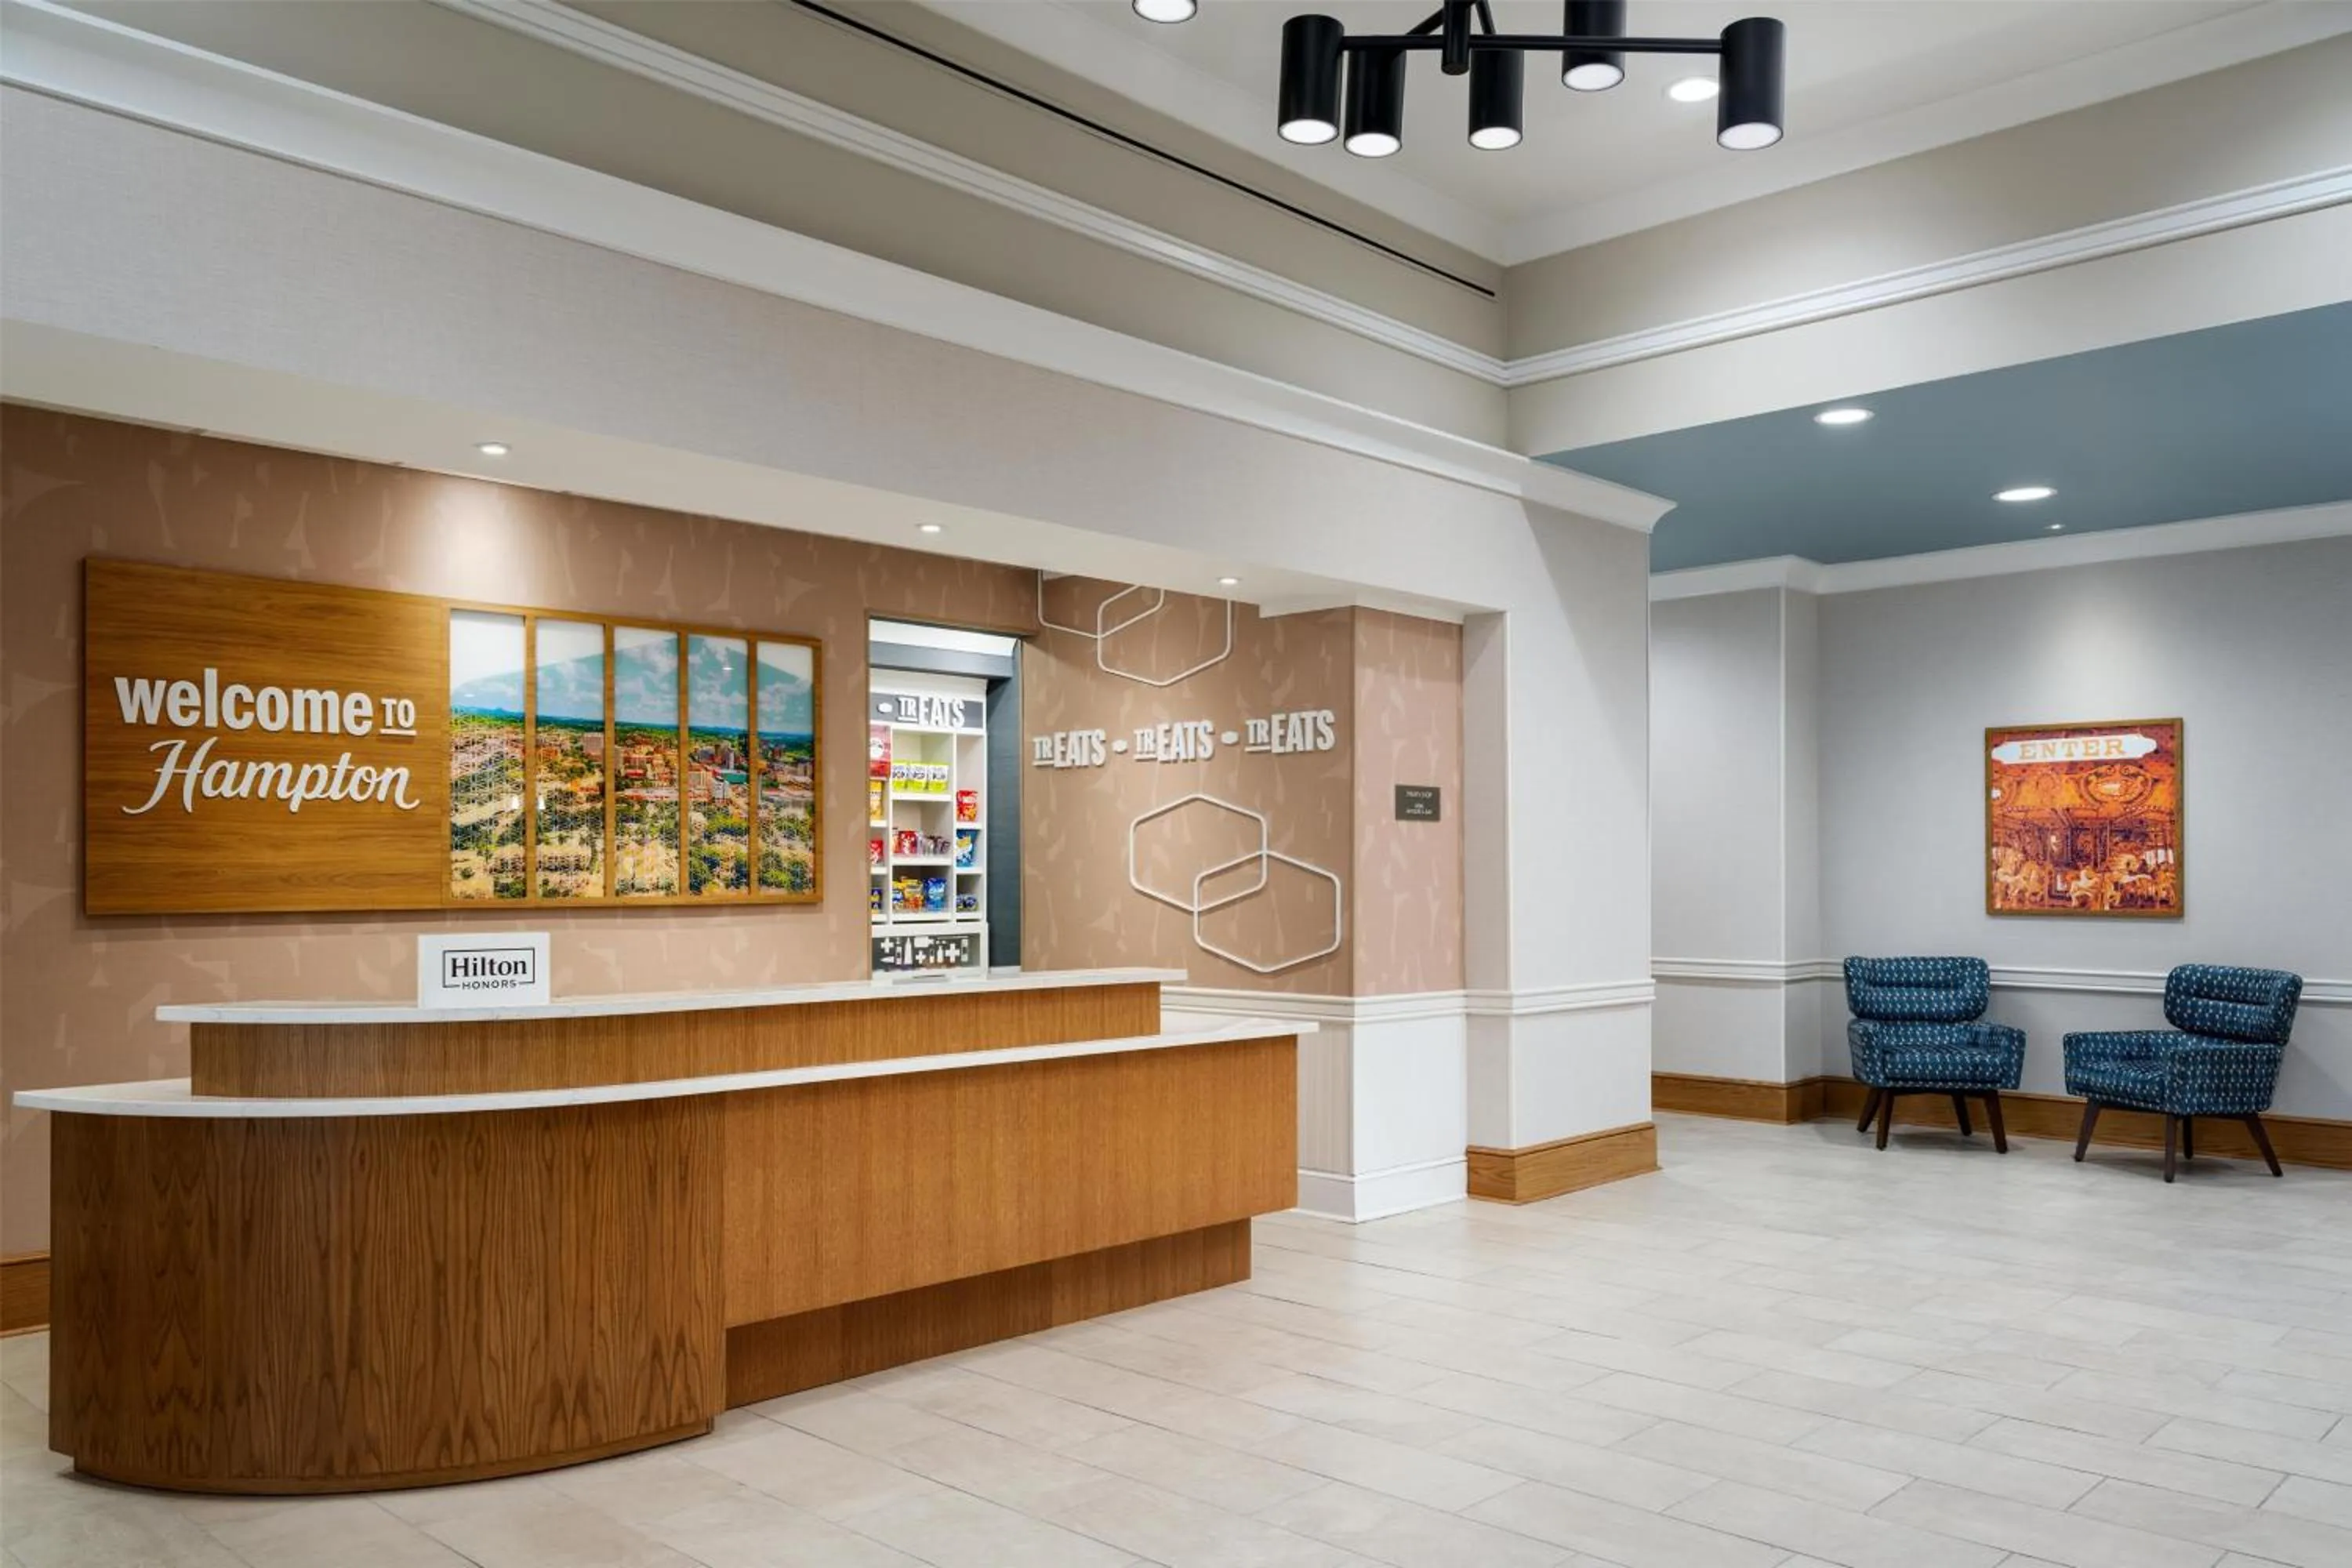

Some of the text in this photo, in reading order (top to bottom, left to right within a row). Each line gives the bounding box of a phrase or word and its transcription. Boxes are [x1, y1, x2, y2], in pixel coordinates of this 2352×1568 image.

[114, 668, 417, 737] welcome TO
[897, 695, 965, 728] TREATS
[1033, 710, 1334, 768] TREATS TREATS TREATS
[2019, 738, 2127, 760] ENTER
[122, 736, 420, 814] Hampton
[451, 956, 528, 978] Hilton
[462, 979, 517, 990] HONORS
